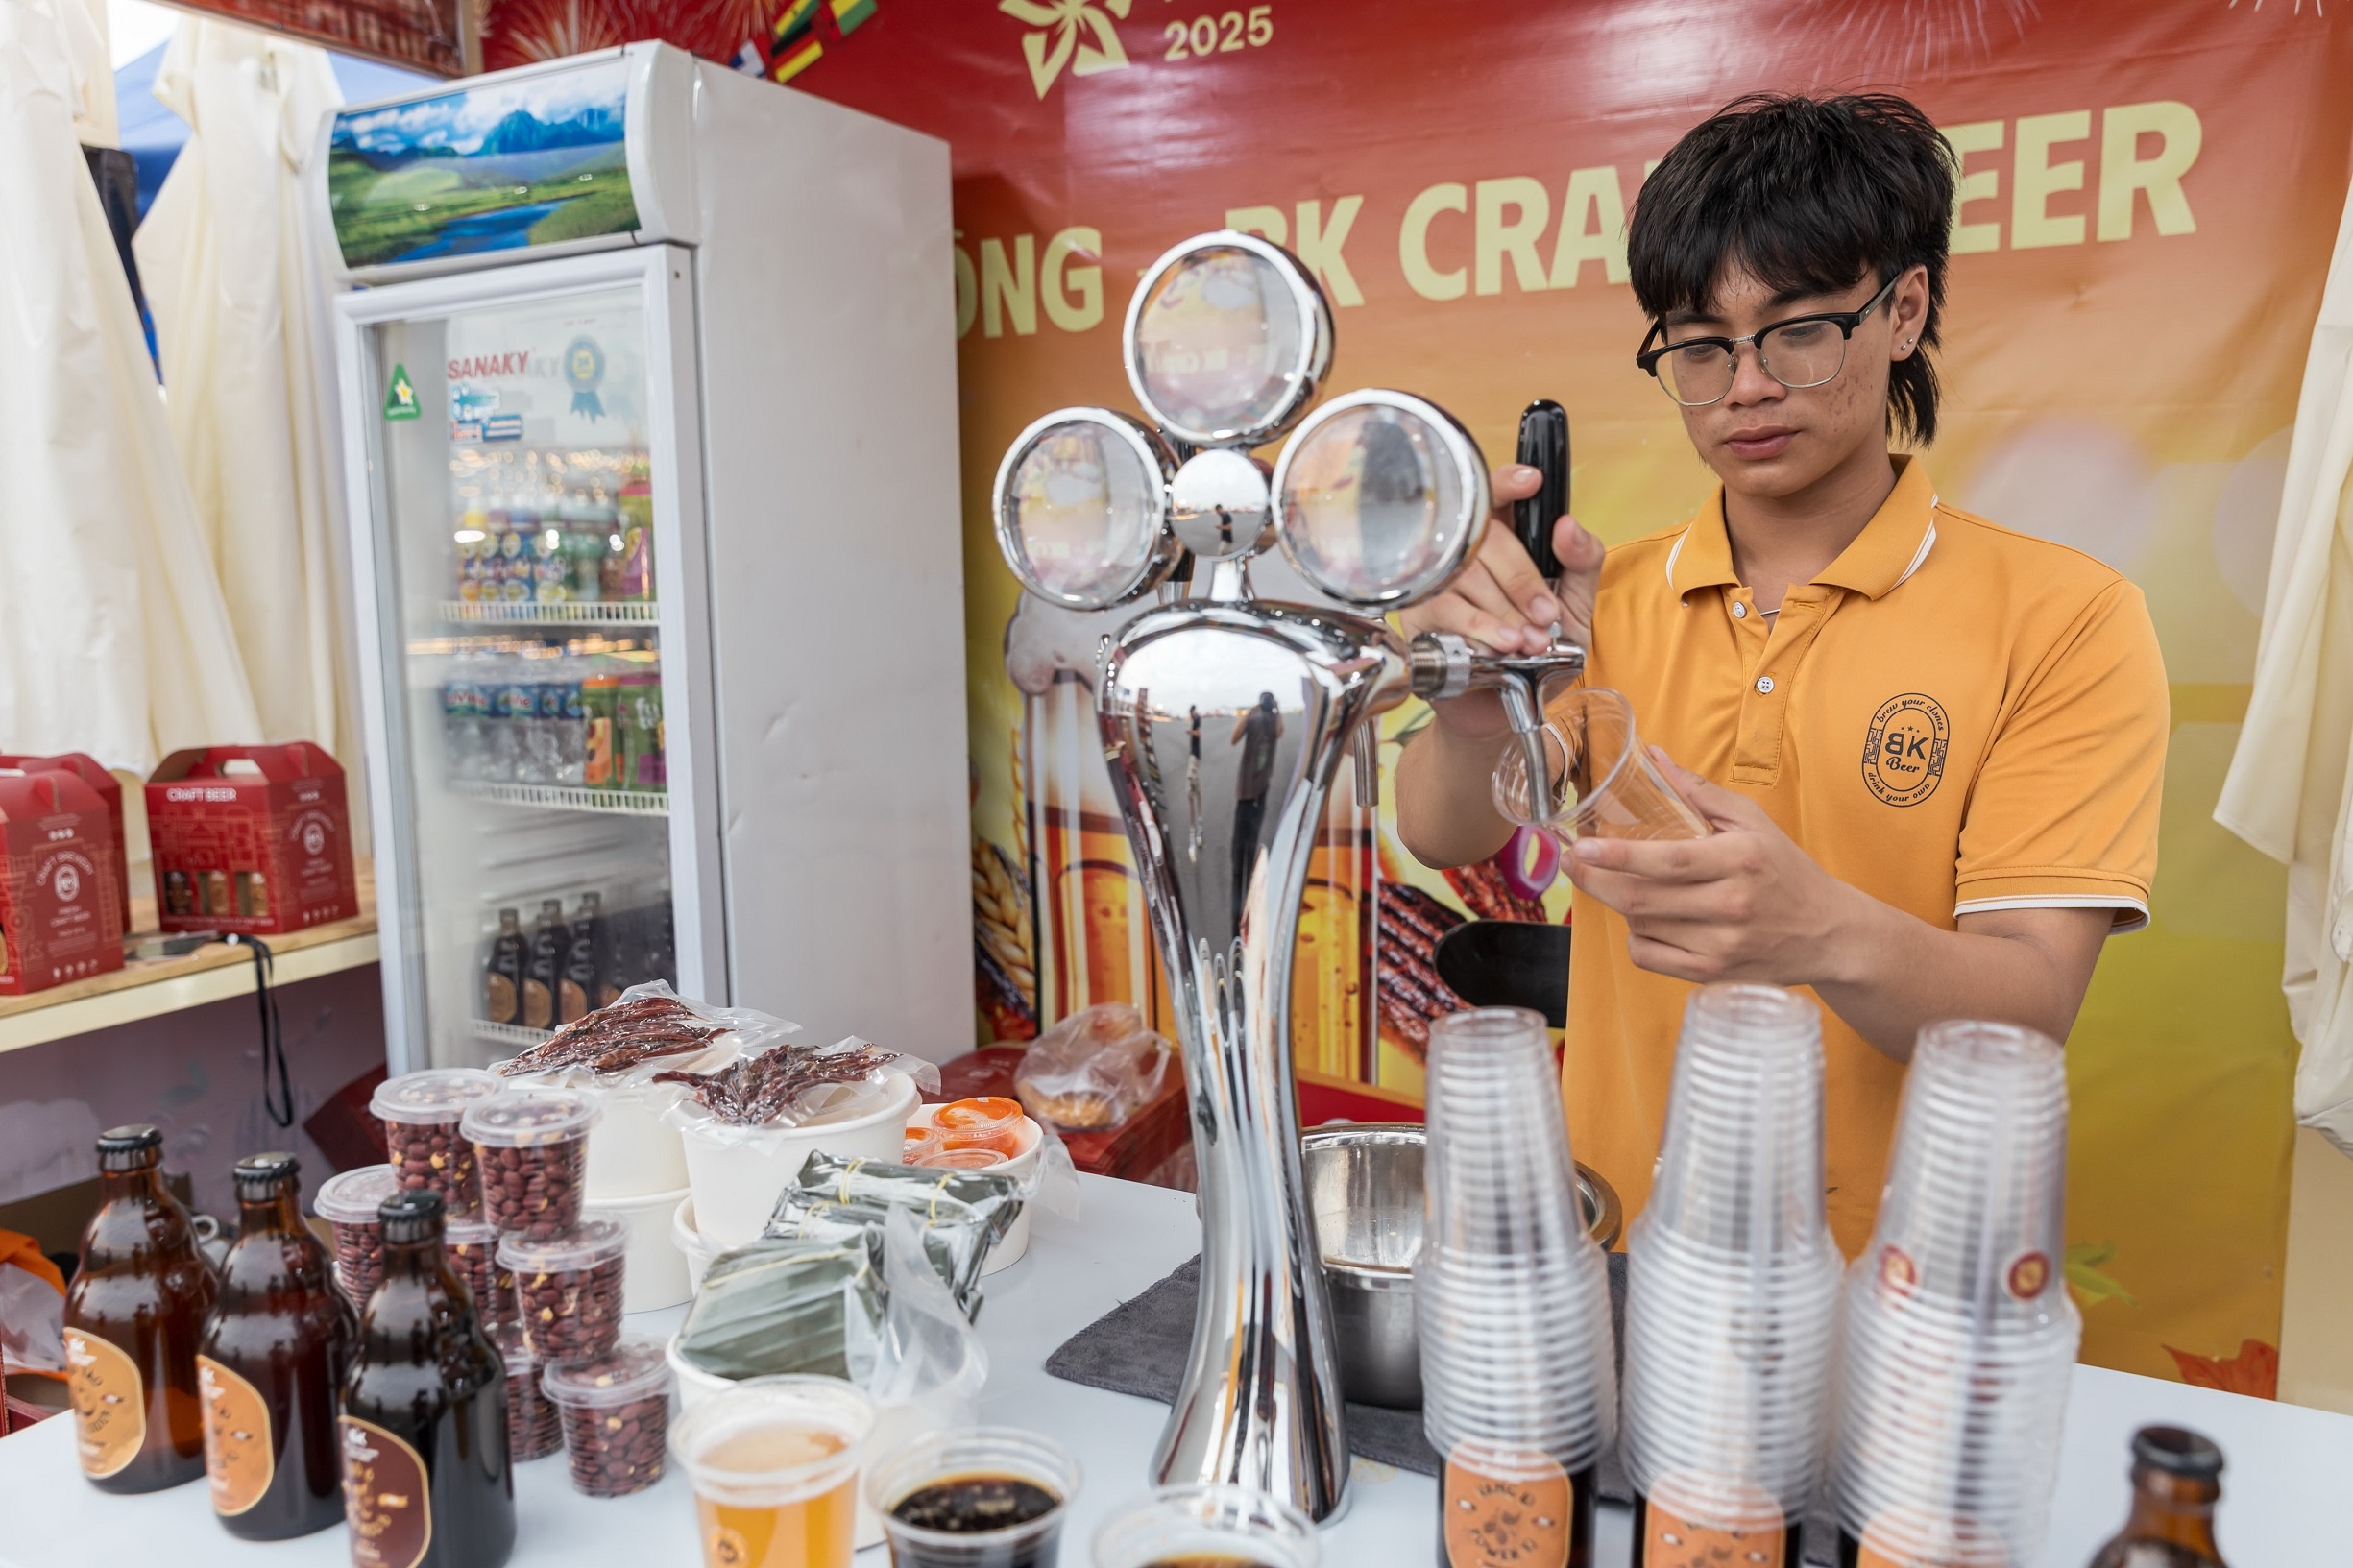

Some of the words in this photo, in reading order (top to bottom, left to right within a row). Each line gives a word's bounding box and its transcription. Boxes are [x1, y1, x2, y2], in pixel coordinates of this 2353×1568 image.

[1164, 5, 1274, 61] 2025
[1398, 159, 1662, 301] CRA
[1941, 101, 2203, 254] EER
[448, 350, 530, 381] SANAKY
[1876, 702, 1898, 723] brew
[1901, 698, 1925, 709] your
[1884, 732, 1929, 760] BK
[1885, 756, 1920, 773] Beer
[166, 787, 204, 802] CRAFT
[204, 787, 237, 802] BEER
[1868, 772, 1885, 795] drink
[1885, 793, 1910, 803] your
[1912, 783, 1930, 799] own
